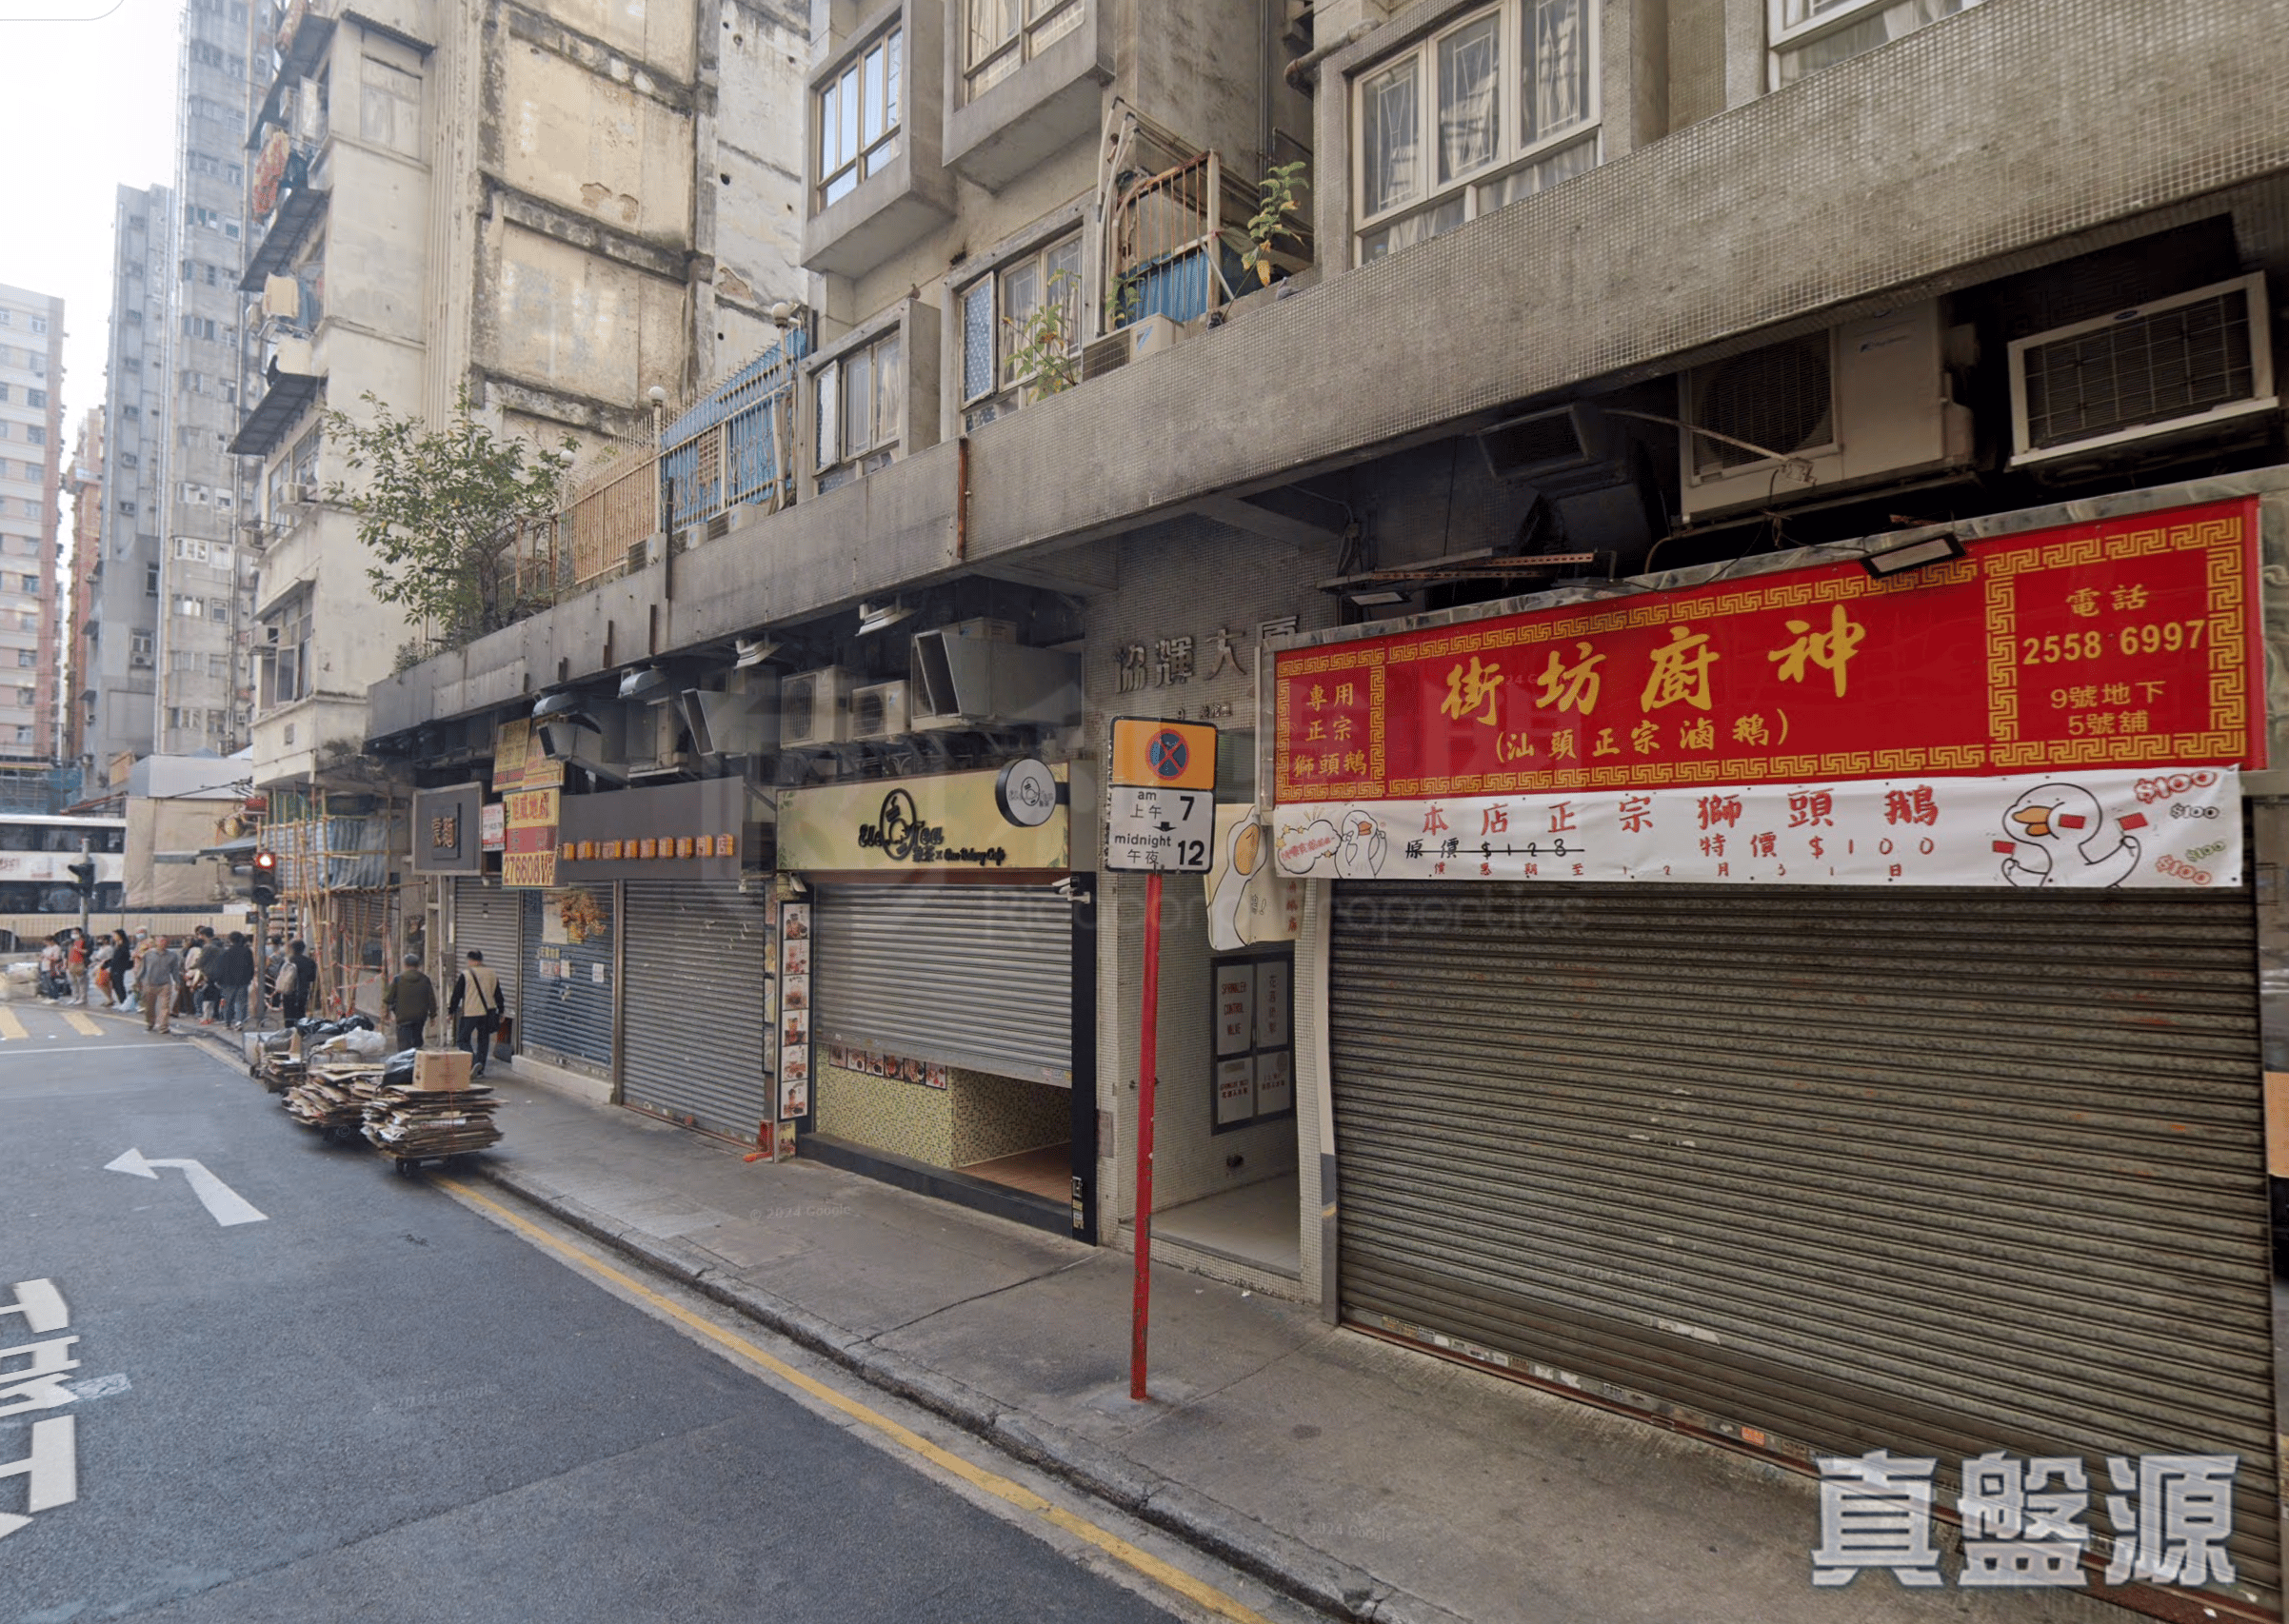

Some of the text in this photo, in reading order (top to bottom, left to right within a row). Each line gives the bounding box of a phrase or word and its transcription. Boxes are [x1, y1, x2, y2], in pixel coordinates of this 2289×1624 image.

[2065, 583, 2150, 618] 電話
[2022, 619, 2206, 666] 2558 6997
[1441, 604, 1865, 726] 街坊廚神
[1305, 683, 1354, 712] 專用
[2050, 680, 2167, 709] 9號地下
[1304, 715, 1353, 742] 正宗
[2068, 709, 2150, 736] 5號舖
[1292, 749, 1368, 780] 獅頭鵝
[1137, 791, 1158, 802] am
[2133, 769, 2218, 804] $100
[1129, 803, 1163, 820] 上午
[1180, 796, 1195, 822] 7
[1422, 784, 1940, 838] 本店正宗獅頭鵝
[2169, 802, 2220, 819] $100
[1114, 833, 1172, 848] midnight
[1177, 841, 1205, 866] 12
[1700, 831, 1935, 859] 特價$100
[1126, 848, 1160, 864] 午夜
[2155, 853, 2213, 885] $100
